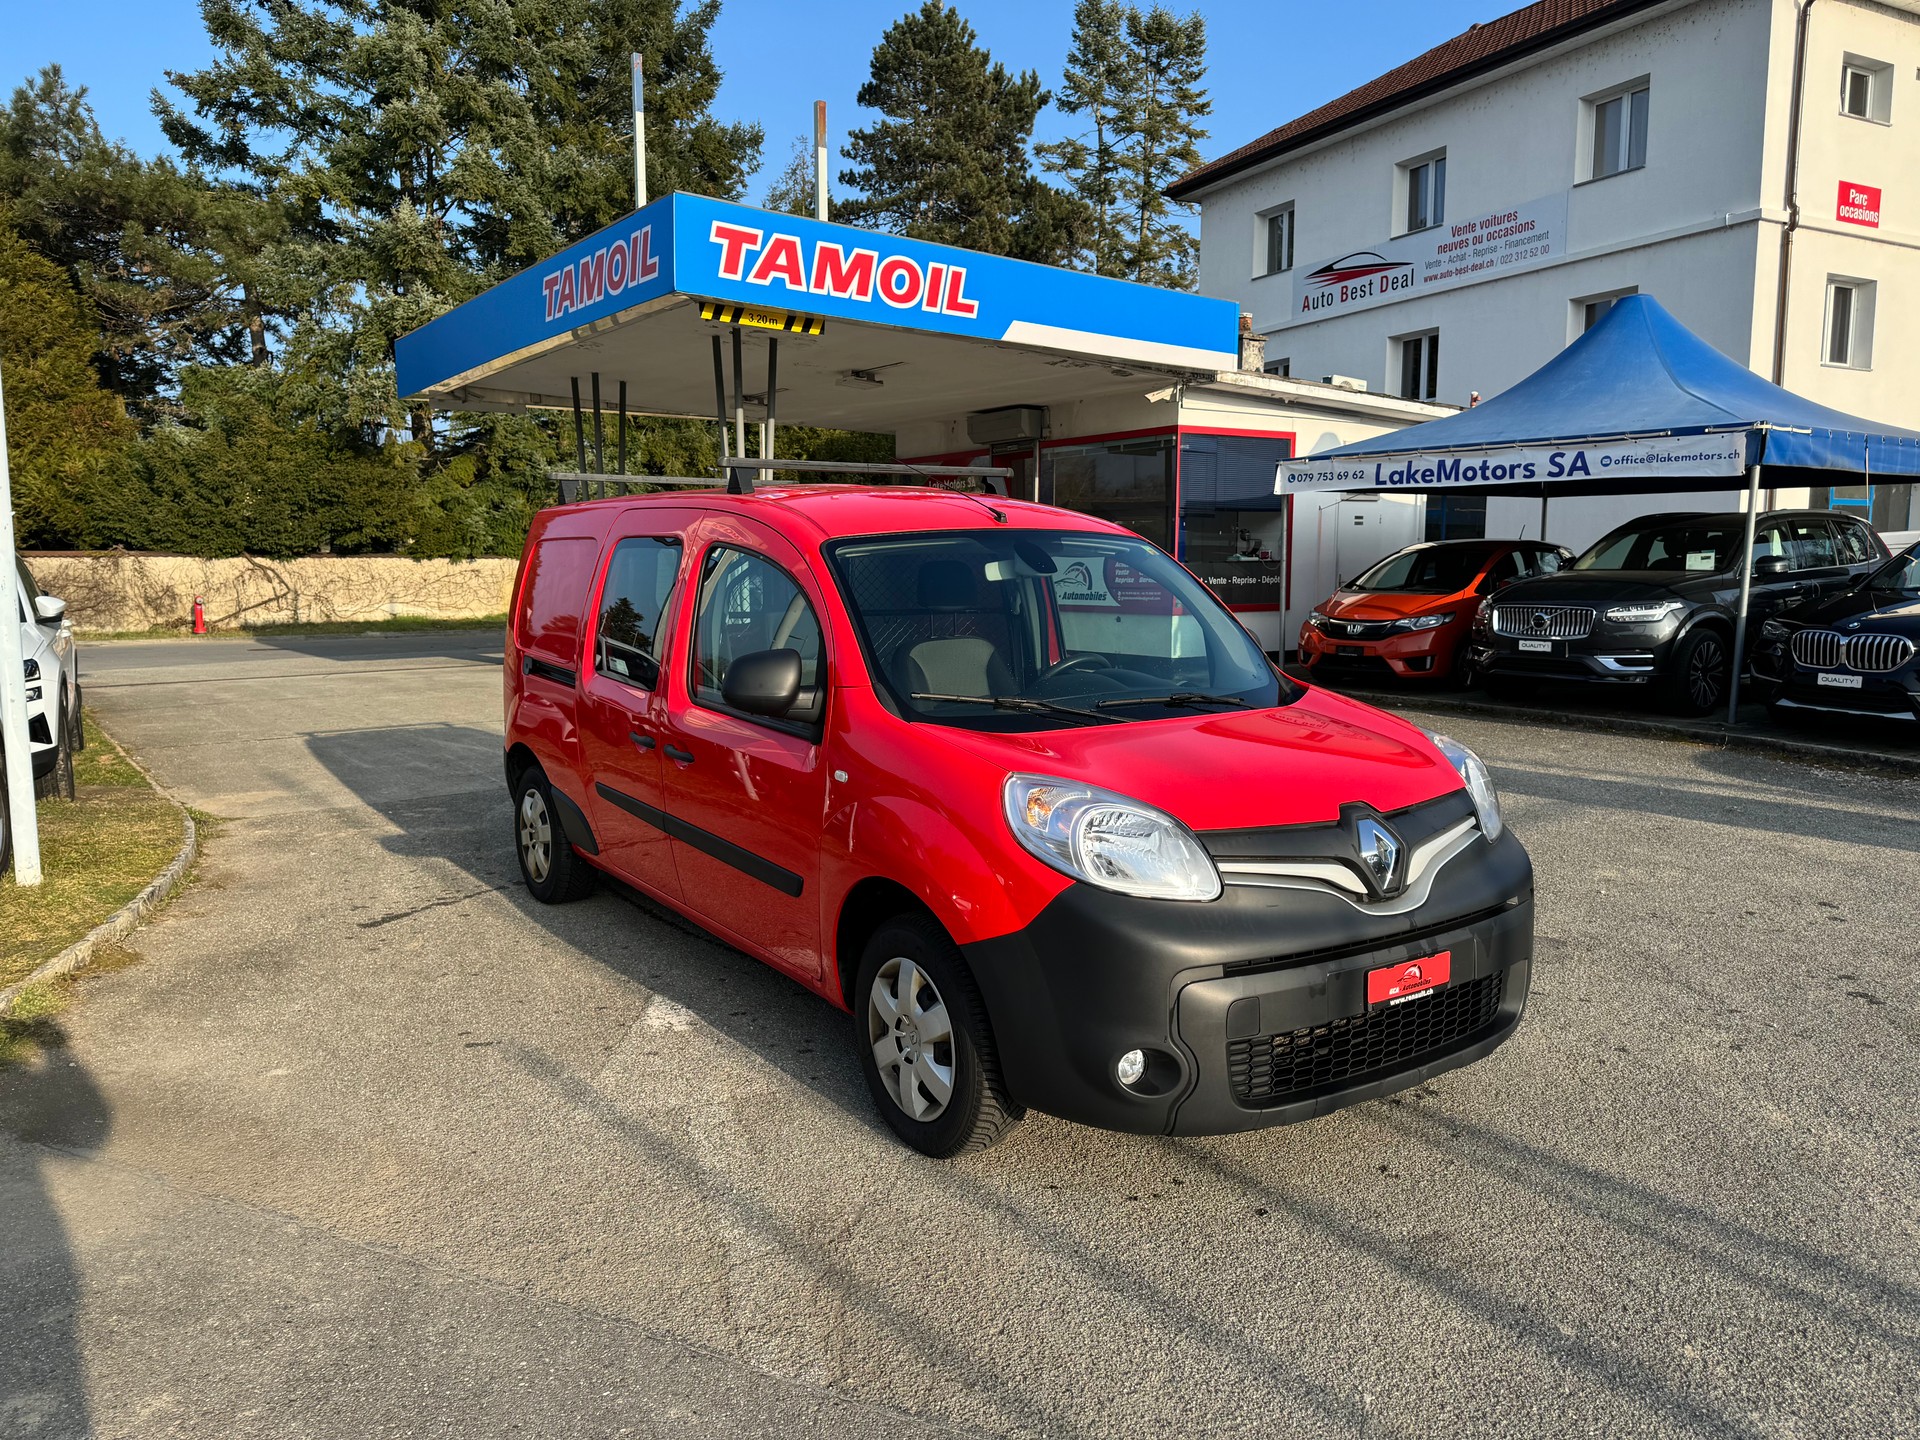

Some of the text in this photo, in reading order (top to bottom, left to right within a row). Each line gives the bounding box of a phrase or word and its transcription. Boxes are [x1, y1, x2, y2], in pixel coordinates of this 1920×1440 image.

[1849, 188, 1868, 206] Parc
[1451, 210, 1518, 238] Vente voitures
[1839, 205, 1879, 223] occasions
[1424, 258, 1443, 270] Vente
[1447, 253, 1467, 265] Achat
[1473, 244, 1498, 260] Reprise
[1504, 230, 1549, 251] Financement
[1437, 219, 1536, 256] neuves ou occasions
[542, 224, 659, 323] TAMOIL
[709, 220, 979, 319] TAMOIL
[1423, 260, 1495, 284] www.auto-best-deal.ch
[1500, 253, 1513, 266] 022
[1514, 251, 1527, 263] 312
[1529, 247, 1539, 260] 52
[1540, 244, 1550, 256] 00
[1302, 268, 1415, 313] Auto Best Deal
[967, 476, 976, 487] SA
[1296, 449, 1740, 486] 079 753 69 62 LakeMotors SA office@lakemotors.ch
[1062, 591, 1107, 601] Automobiles
[1208, 576, 1227, 585] Vente
[1232, 575, 1257, 586] Reprise
[1821, 676, 1854, 685] QUALITY
